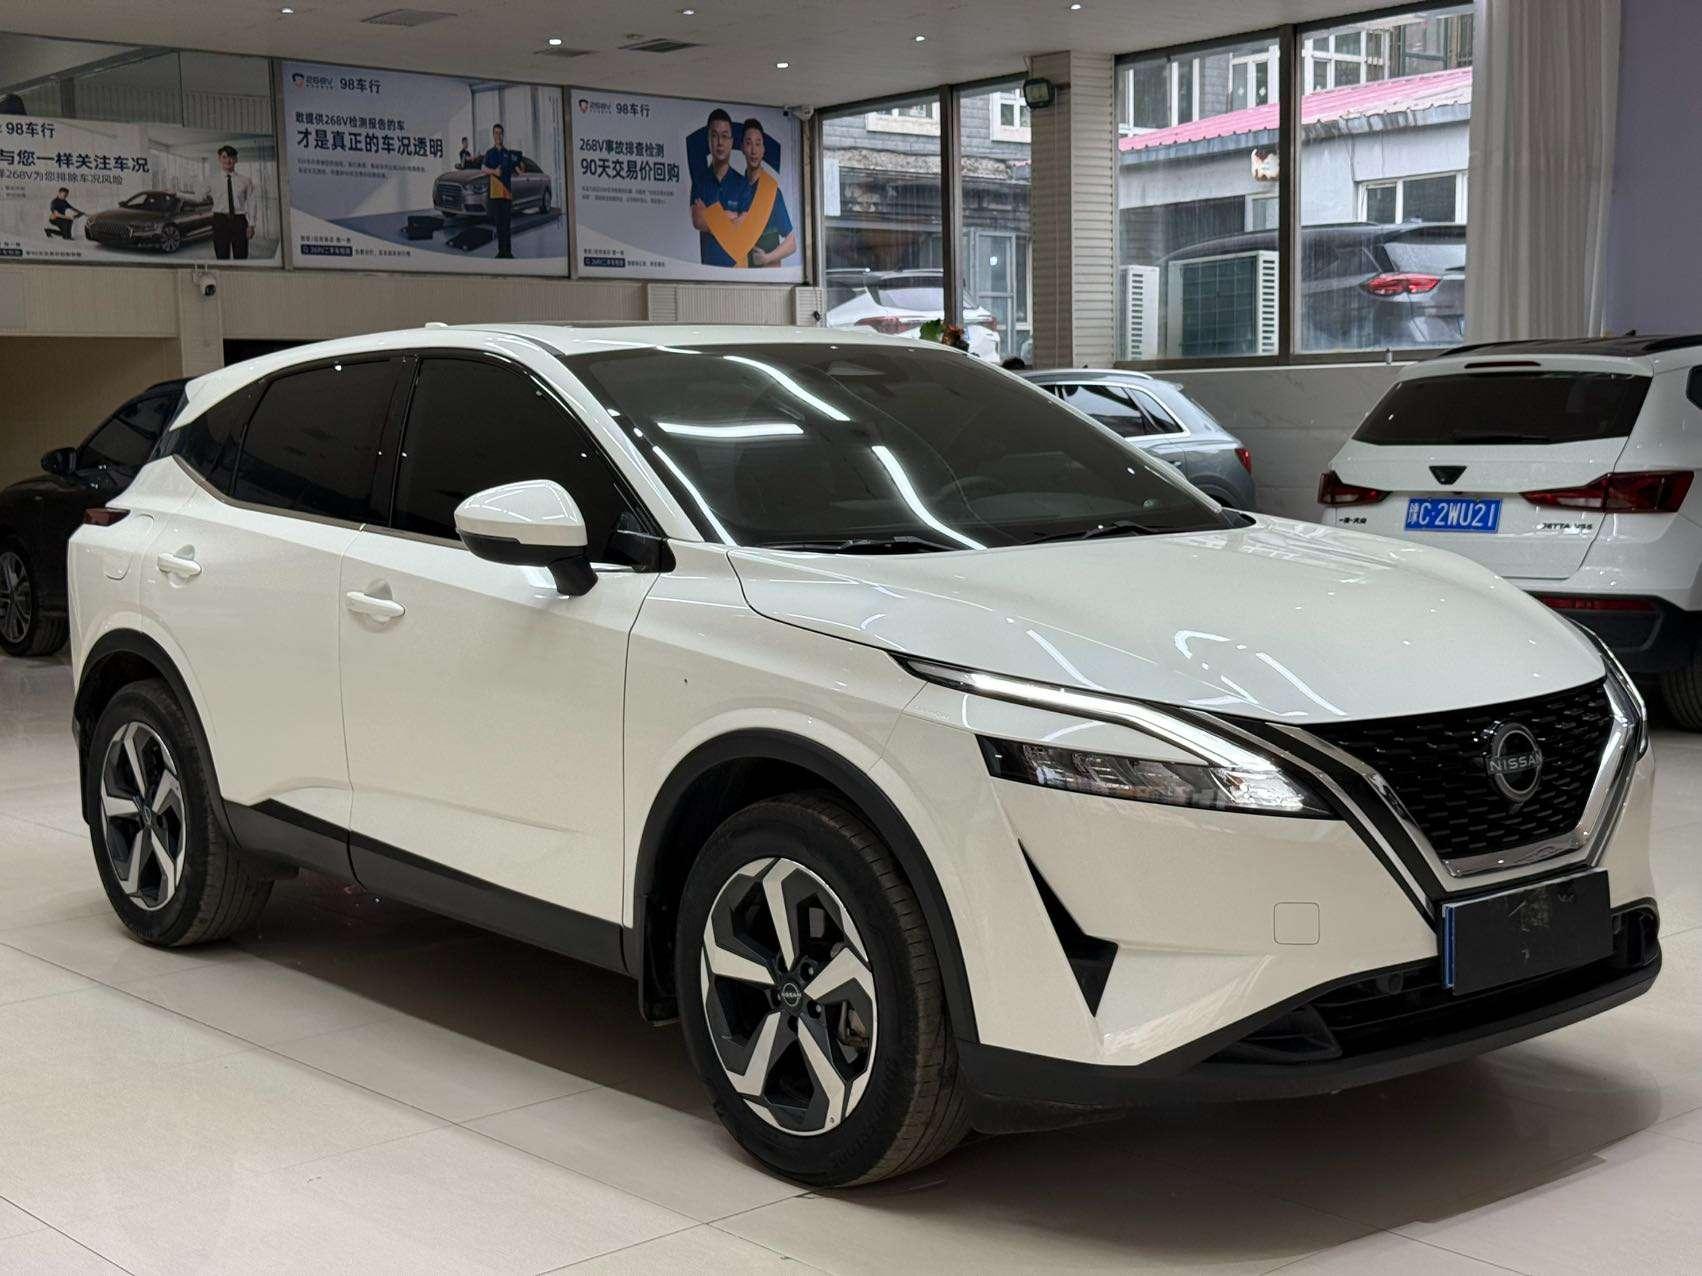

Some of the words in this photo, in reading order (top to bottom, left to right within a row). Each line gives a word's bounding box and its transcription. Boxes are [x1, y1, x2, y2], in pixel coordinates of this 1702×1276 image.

[339, 77, 382, 94] 98车行
[615, 103, 650, 117] 98车行
[6, 122, 56, 138] 98车行
[296, 129, 444, 159] 才是真正的车况透明
[580, 138, 665, 158] 268V事故排查检测
[0, 149, 150, 173] 与您一样关注车况
[581, 158, 680, 183] 90天交易价回购
